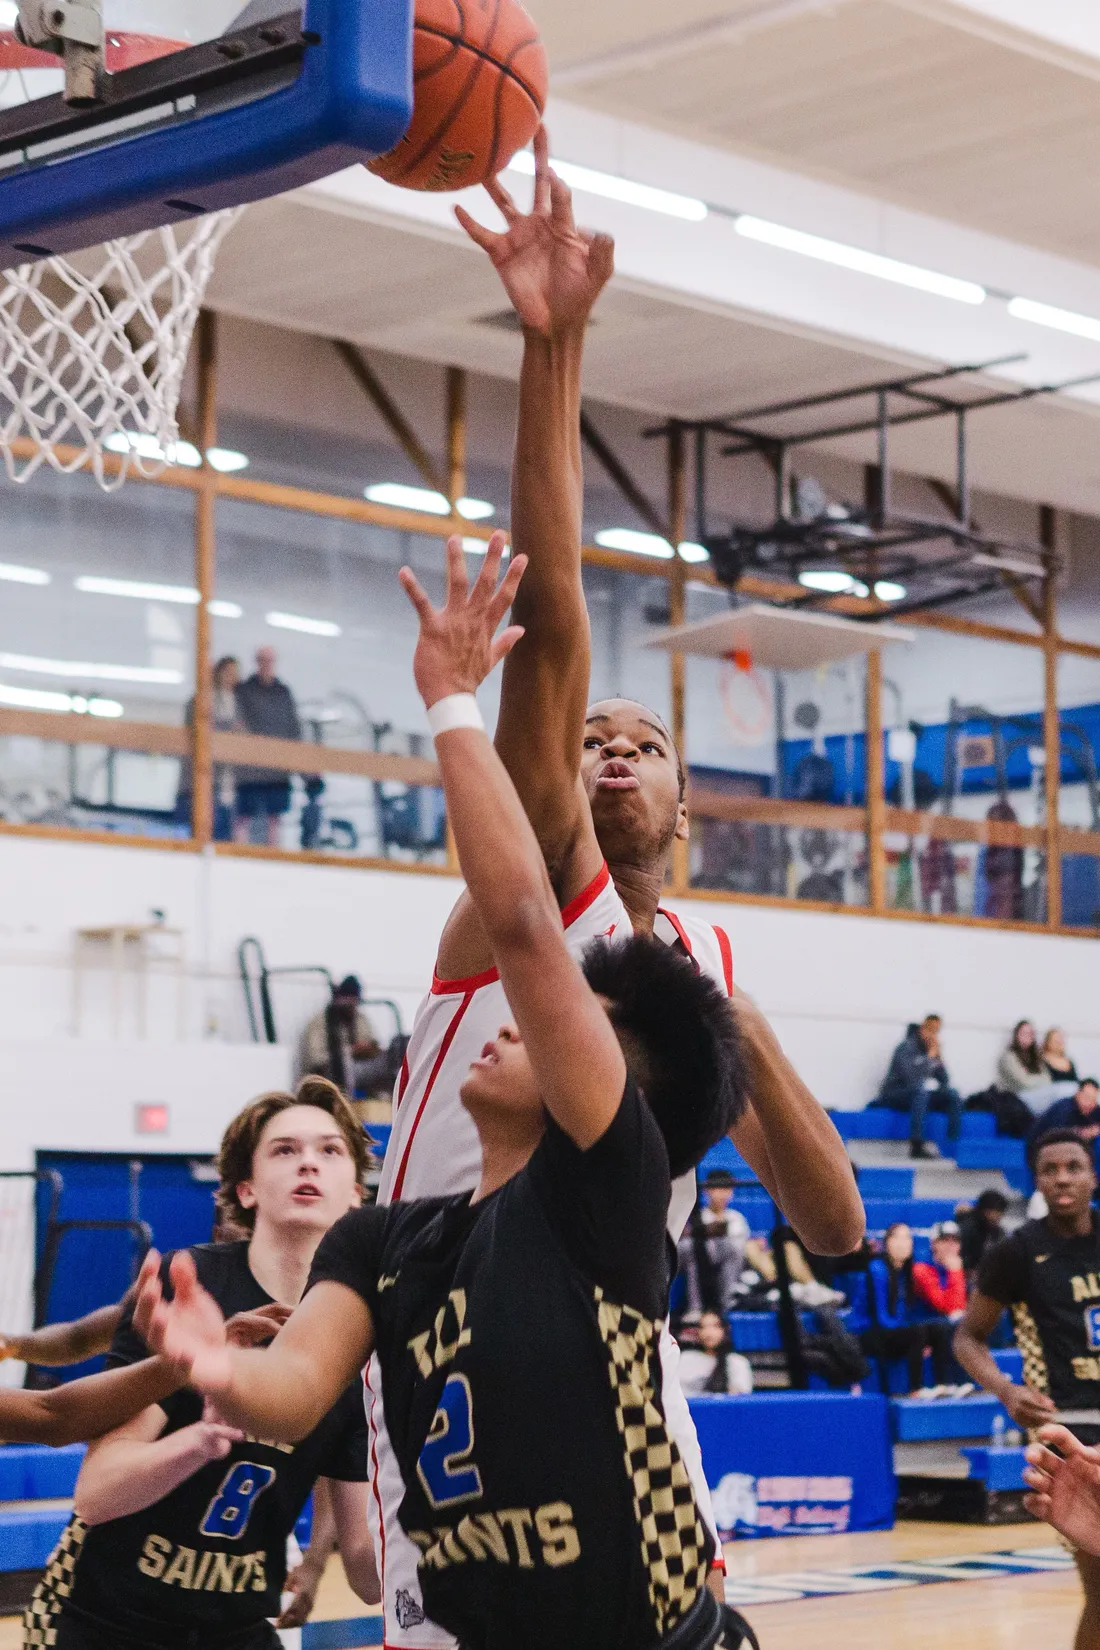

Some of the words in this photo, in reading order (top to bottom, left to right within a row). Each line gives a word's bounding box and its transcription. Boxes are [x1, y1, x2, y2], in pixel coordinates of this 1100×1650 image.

[416, 1371, 484, 1511] 2
[198, 1460, 277, 1541] 8
[136, 1533, 269, 1594] SAINTS
